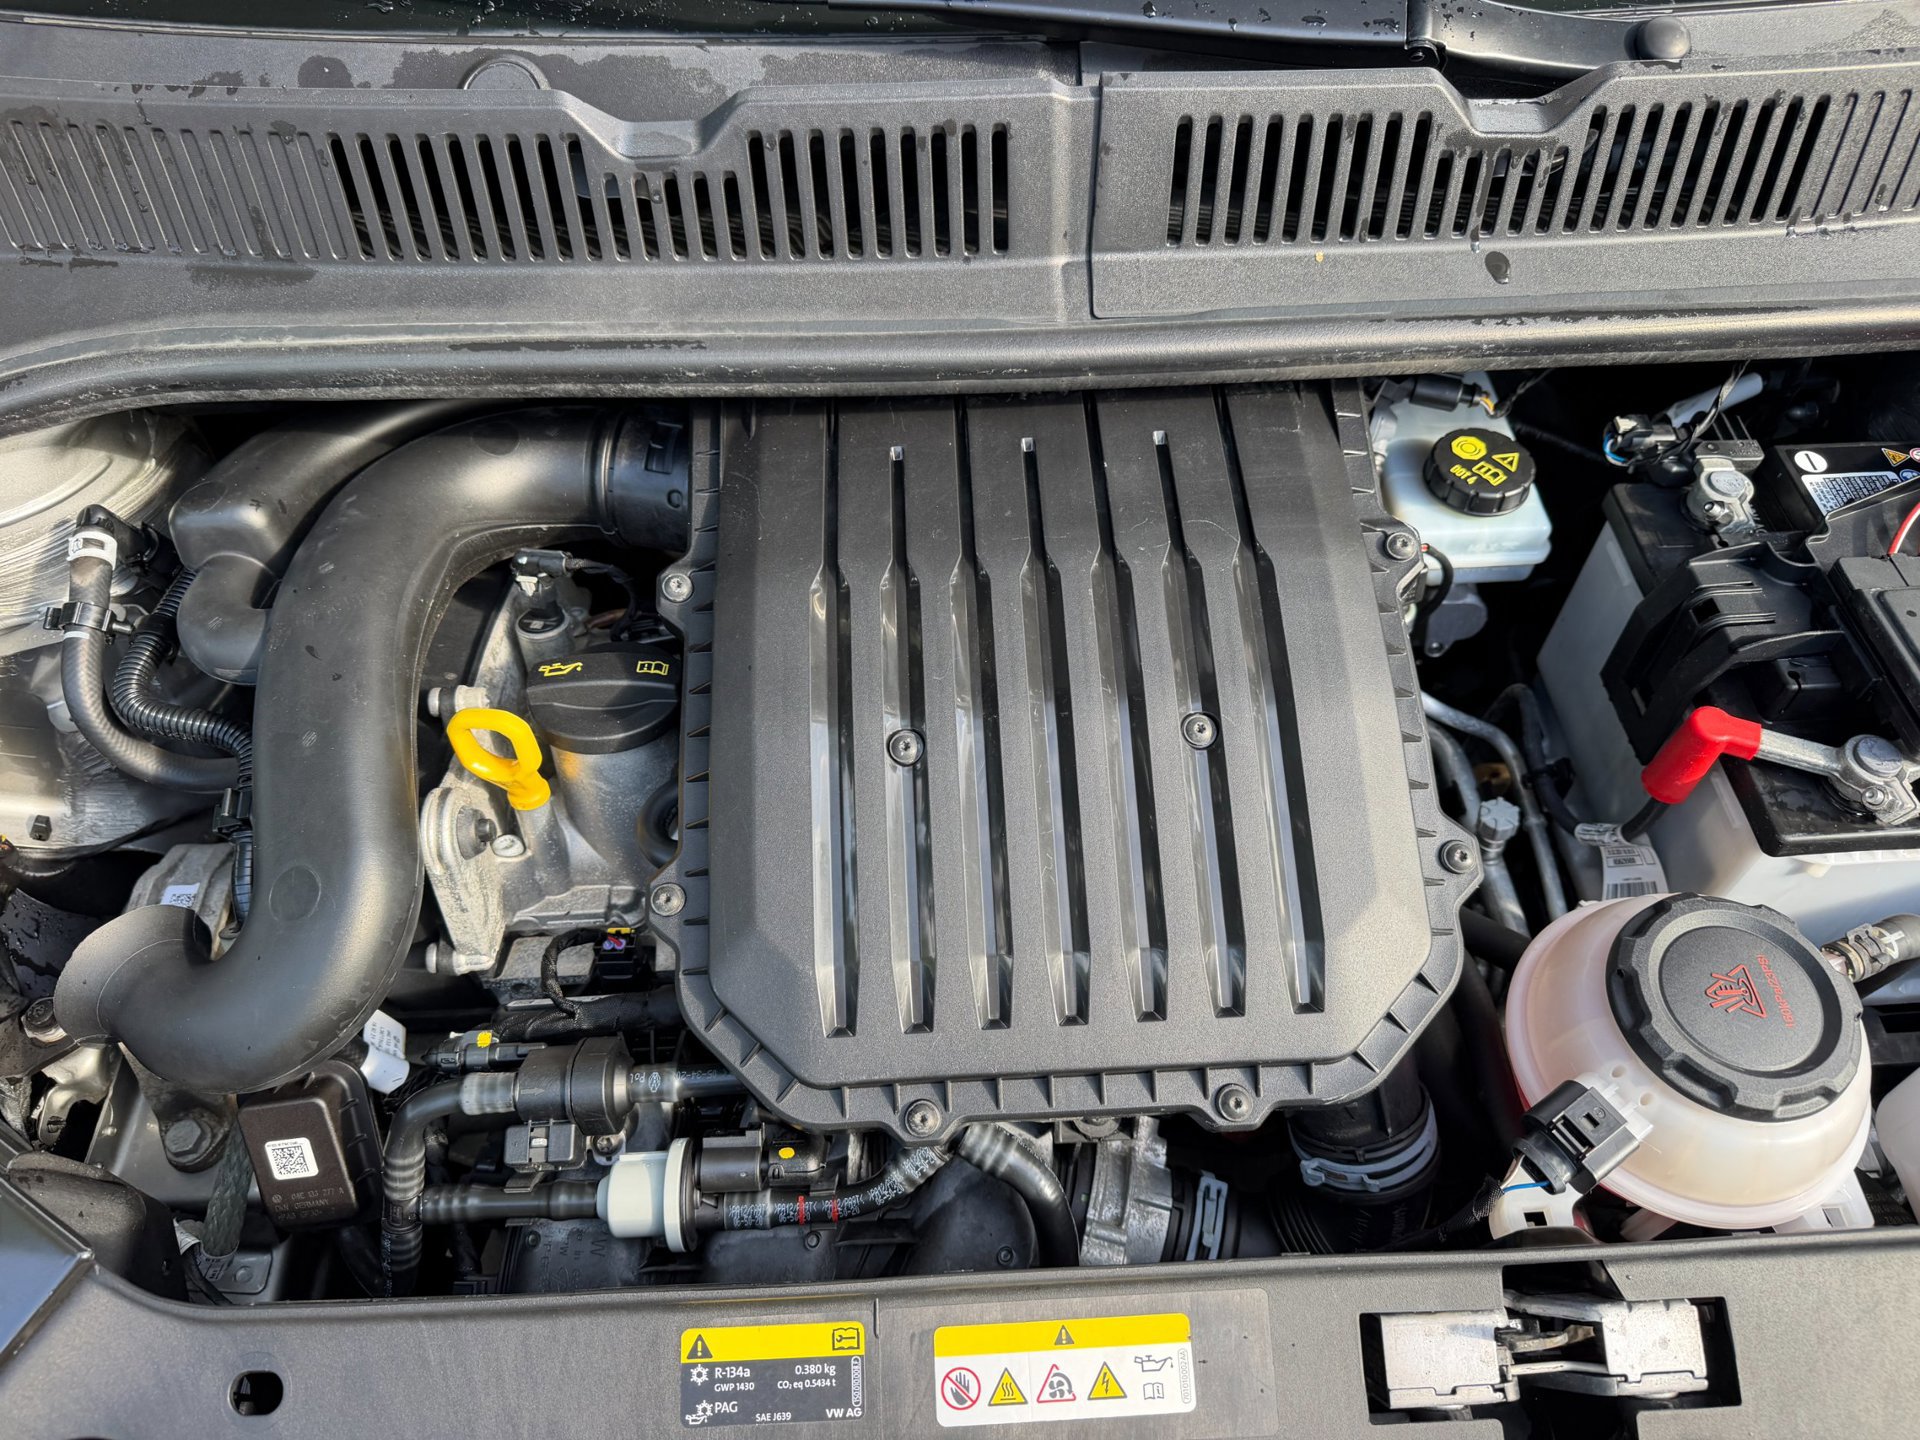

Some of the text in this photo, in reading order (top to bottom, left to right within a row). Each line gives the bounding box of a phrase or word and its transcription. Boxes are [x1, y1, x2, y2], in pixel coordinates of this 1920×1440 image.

[1449, 464, 1479, 485] DOT 4
[714, 1363, 836, 1378] R-134a 0.380 kg
[714, 1382, 755, 1392] GWP 1430
[793, 1381, 803, 1390] eq
[804, 1379, 831, 1388] 0.5434
[714, 1401, 738, 1413] PAG
[826, 1407, 862, 1418] VW AG
[755, 1412, 792, 1422] SAE J639
